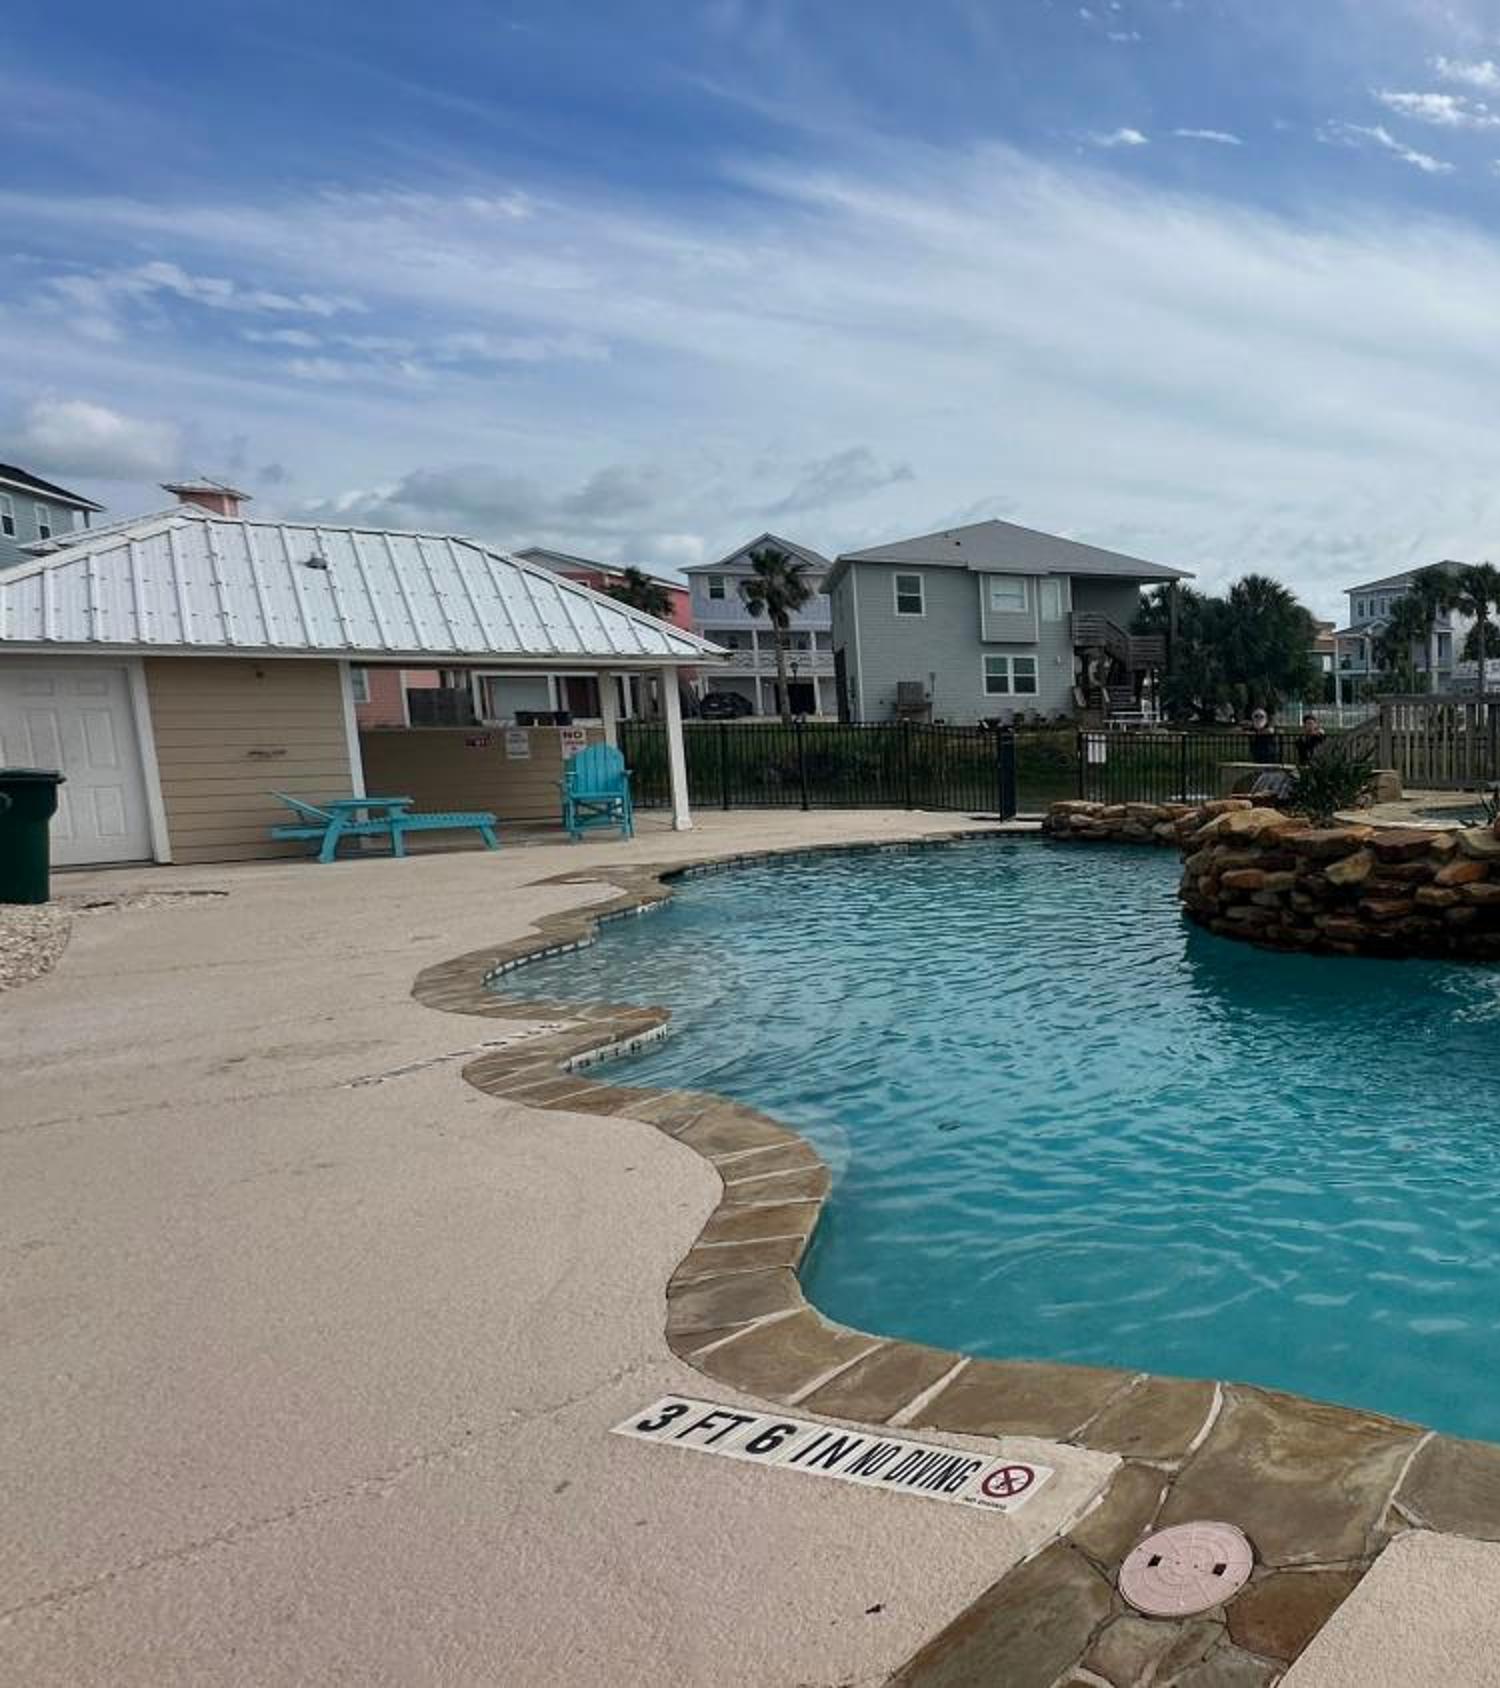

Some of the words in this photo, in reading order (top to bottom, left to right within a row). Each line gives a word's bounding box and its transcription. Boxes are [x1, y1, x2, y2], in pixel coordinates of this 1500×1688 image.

[635, 1404, 690, 1432] 3
[674, 1410, 759, 1445] FT
[745, 1424, 798, 1454] 6
[789, 1432, 865, 1469] IN
[843, 1442, 902, 1477] NO
[882, 1450, 984, 1493] DIVING
